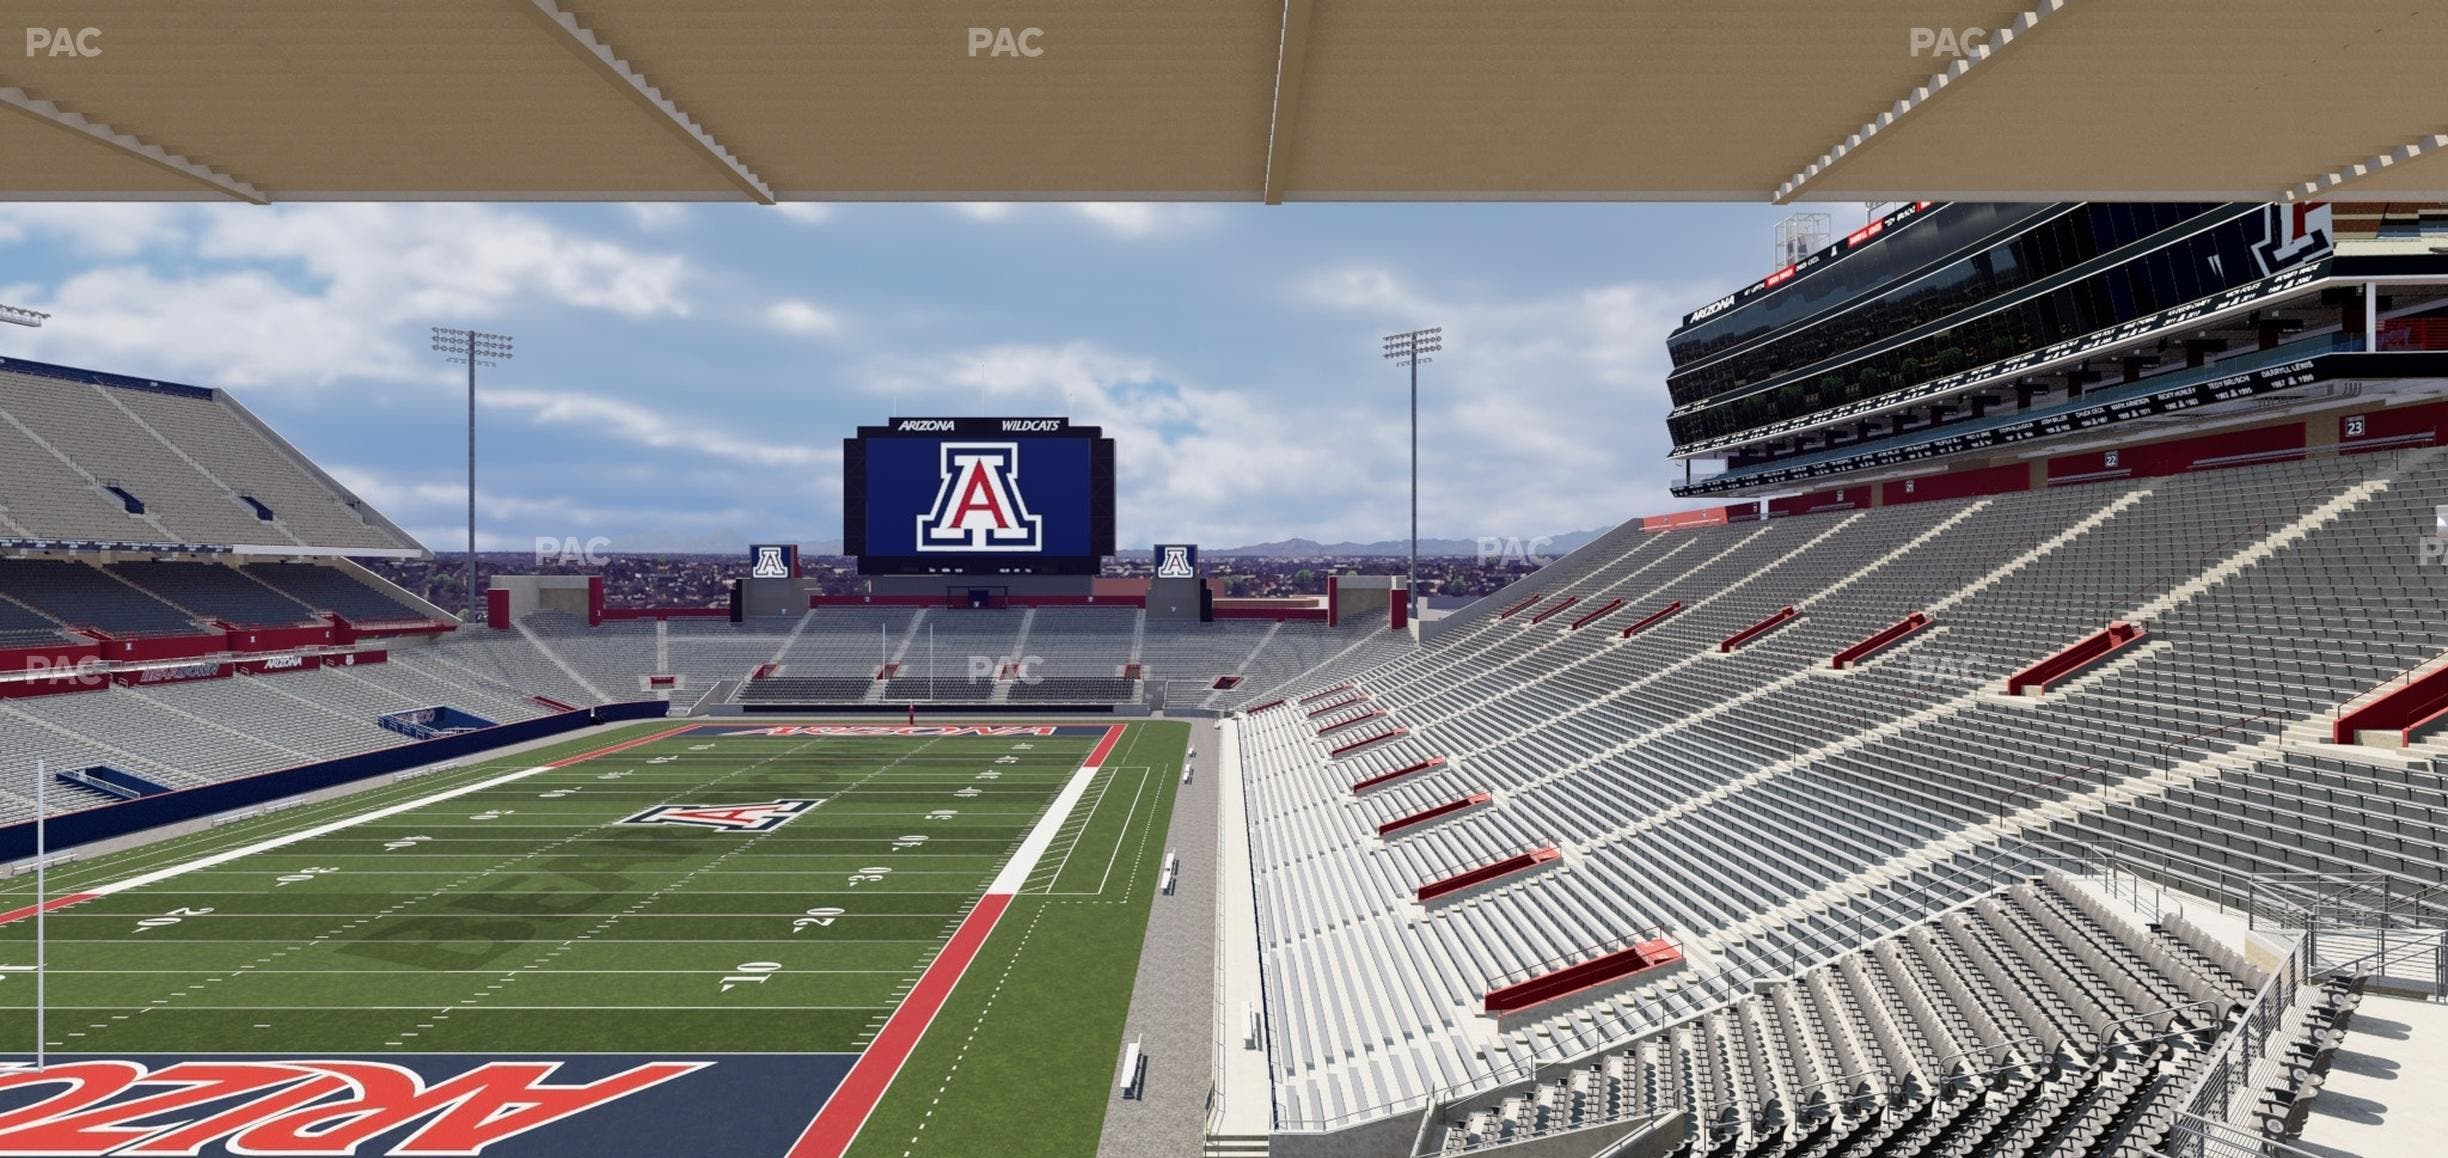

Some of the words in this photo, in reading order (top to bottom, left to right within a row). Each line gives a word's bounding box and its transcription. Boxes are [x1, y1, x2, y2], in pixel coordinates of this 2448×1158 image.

[1690, 295, 1735, 324] ARIZONA
[2292, 361, 2314, 372] LEWIS
[899, 420, 954, 431] ARIZONA
[1001, 420, 1060, 431] WILDCATS
[2348, 421, 2362, 435] 23
[2106, 455, 2116, 466] 22
[916, 442, 1042, 552] A
[752, 546, 789, 578] A
[1157, 546, 1194, 578] A
[264, 655, 302, 669] ARIZONA
[892, 835, 929, 848] 40
[848, 867, 892, 882] 30
[137, 907, 215, 927] 20
[793, 907, 845, 926] 20
[719, 961, 782, 984] 10
